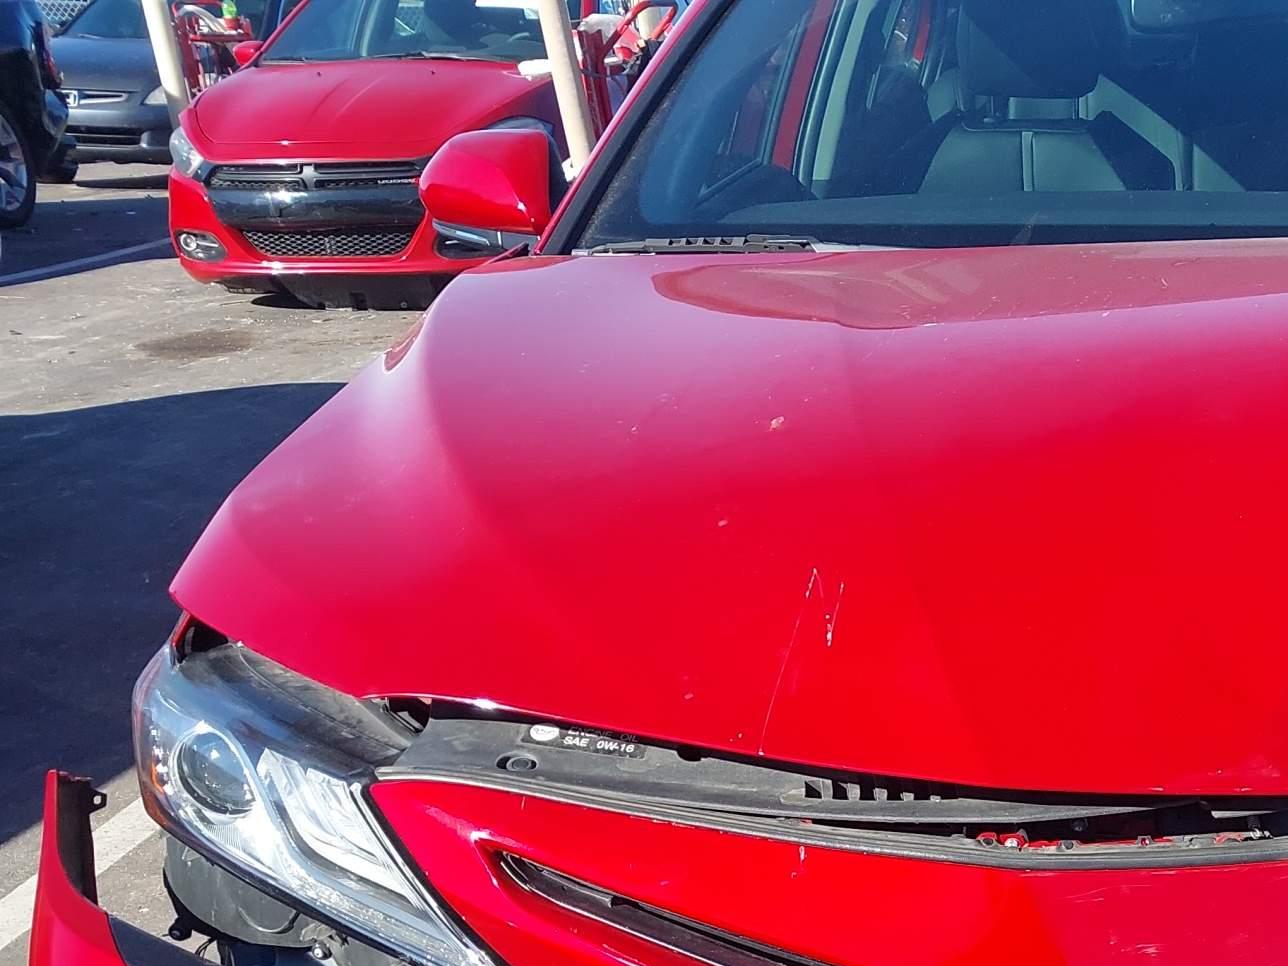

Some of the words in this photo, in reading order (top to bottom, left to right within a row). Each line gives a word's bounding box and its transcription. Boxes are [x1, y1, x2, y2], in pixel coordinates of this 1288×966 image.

[563, 735, 590, 748] SAE
[596, 740, 635, 753] 0W-16
[567, 726, 614, 739] ENGINE
[620, 733, 640, 744] OIL
